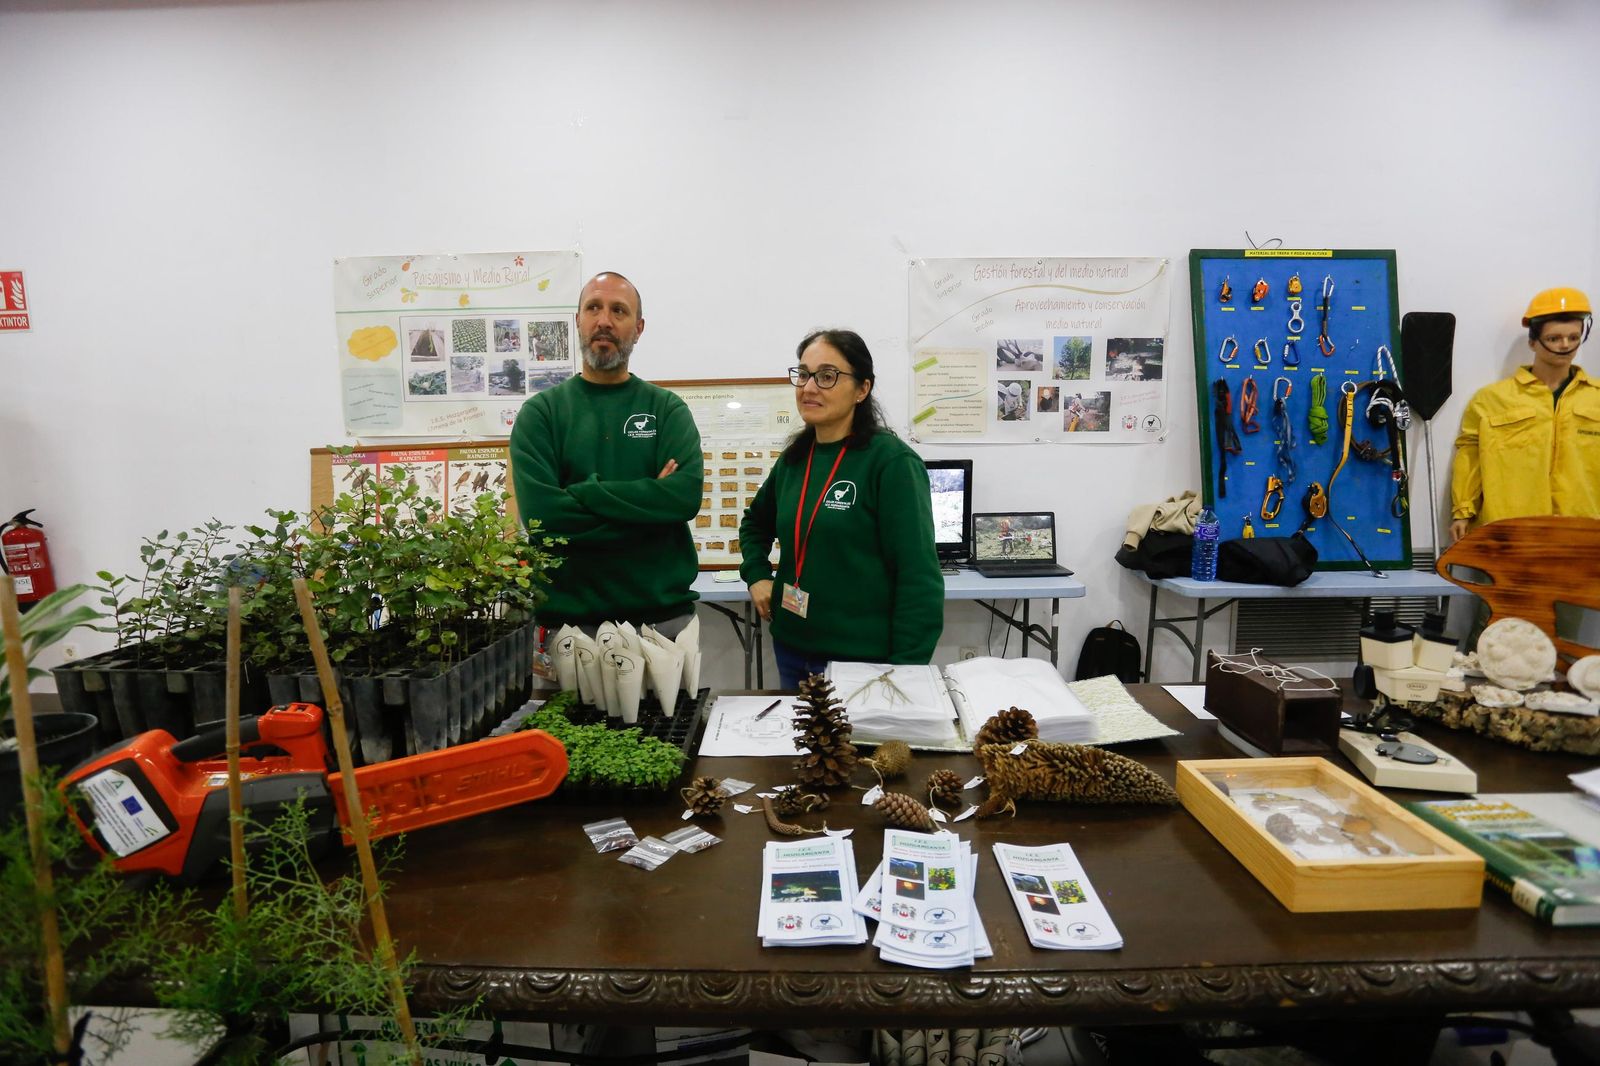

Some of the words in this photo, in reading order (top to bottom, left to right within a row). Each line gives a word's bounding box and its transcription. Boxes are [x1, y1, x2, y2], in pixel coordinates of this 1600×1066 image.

[412, 271, 462, 288] Paisajismo
[473, 267, 500, 284] Medio
[502, 266, 530, 283] Rural
[974, 263, 1008, 281] Gestión
[1010, 263, 1046, 279] forestal
[1055, 264, 1068, 278] del
[1070, 264, 1094, 278] medio
[1097, 264, 1129, 278] natural
[1015, 299, 1086, 312] Aprovechamiento
[1095, 299, 1146, 311] conservación
[0, 316, 28, 327] XTINTOR
[456, 763, 525, 791] STIHL
